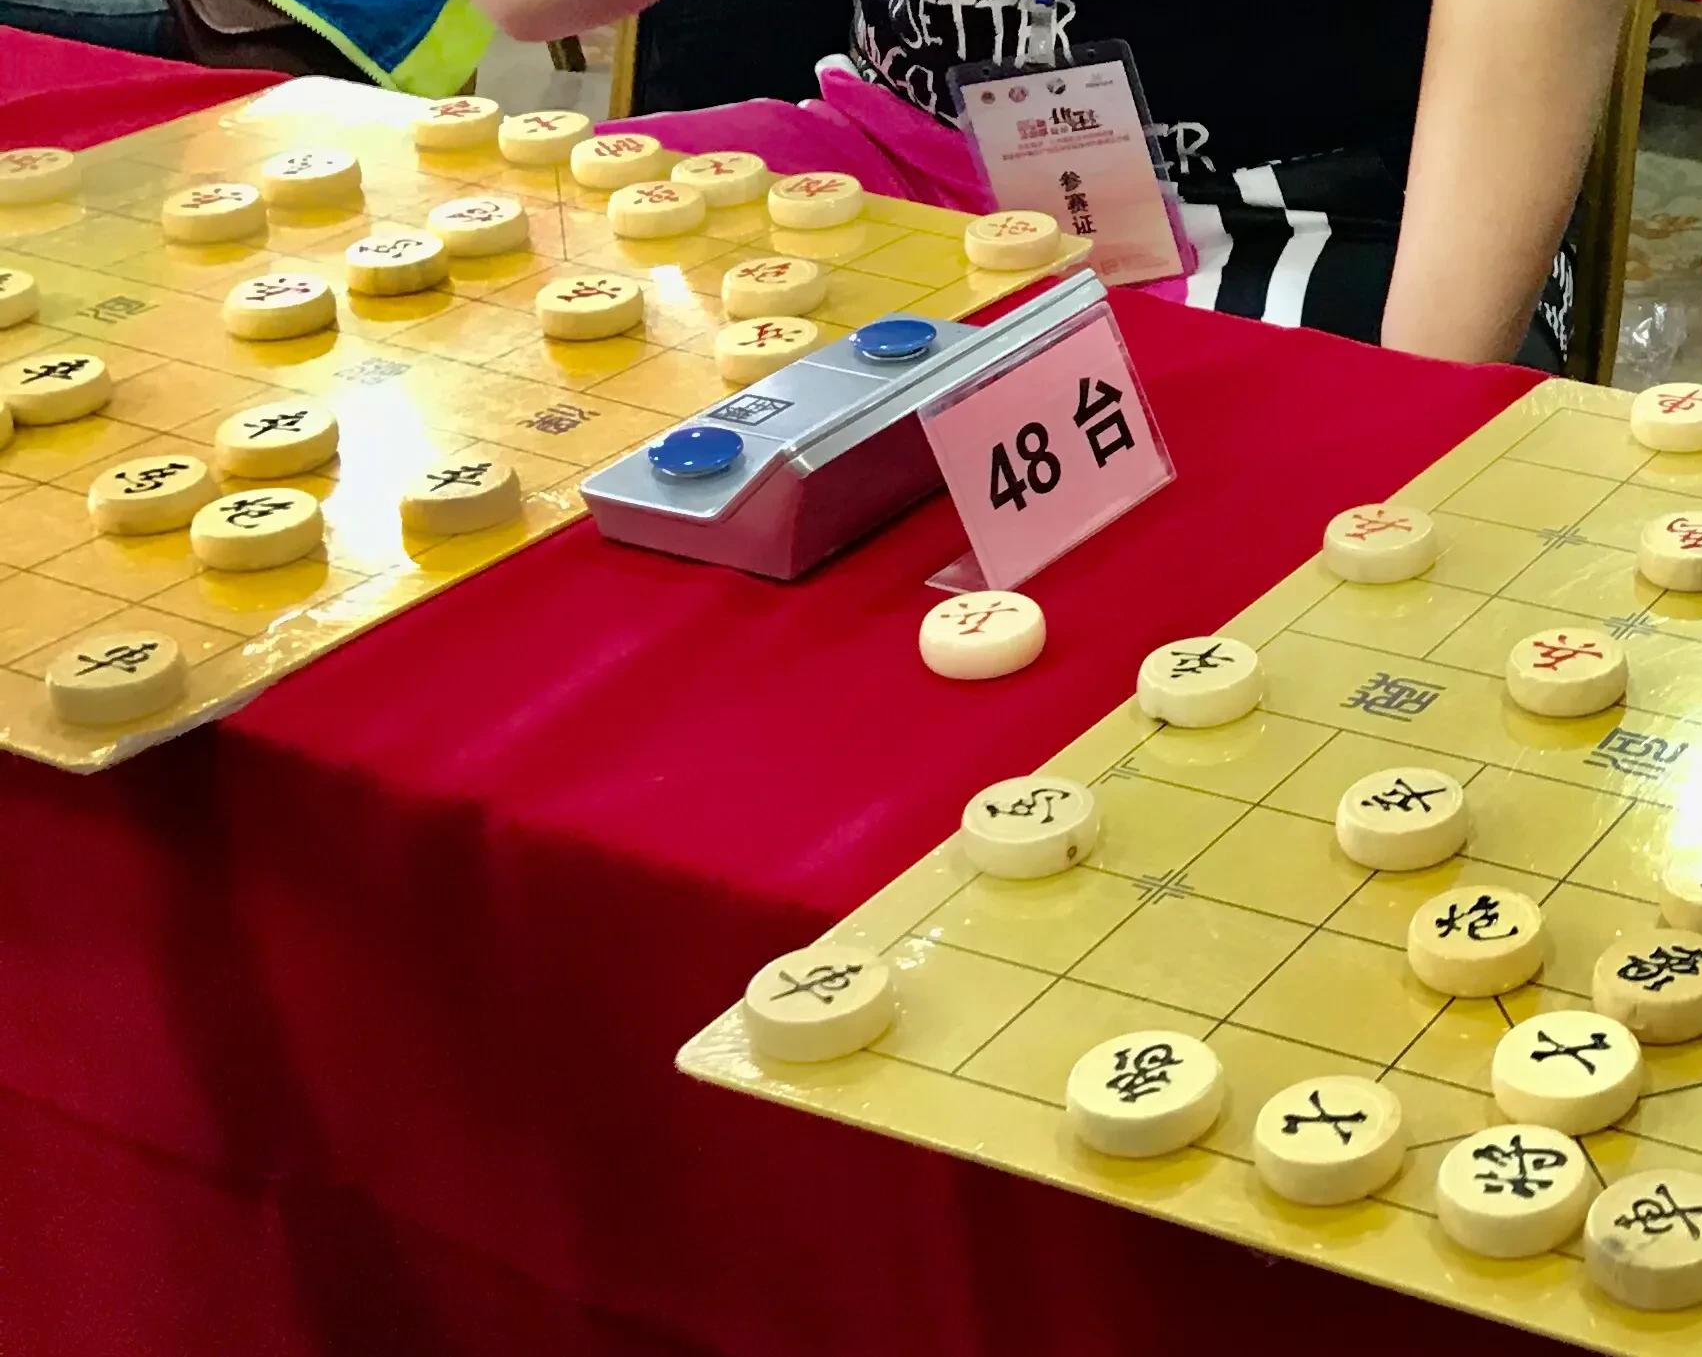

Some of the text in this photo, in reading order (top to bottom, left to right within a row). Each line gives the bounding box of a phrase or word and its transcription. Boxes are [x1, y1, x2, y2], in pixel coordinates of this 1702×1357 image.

[1058, 170, 1097, 235] 参赛证
[989, 376, 1136, 513] 48 台
